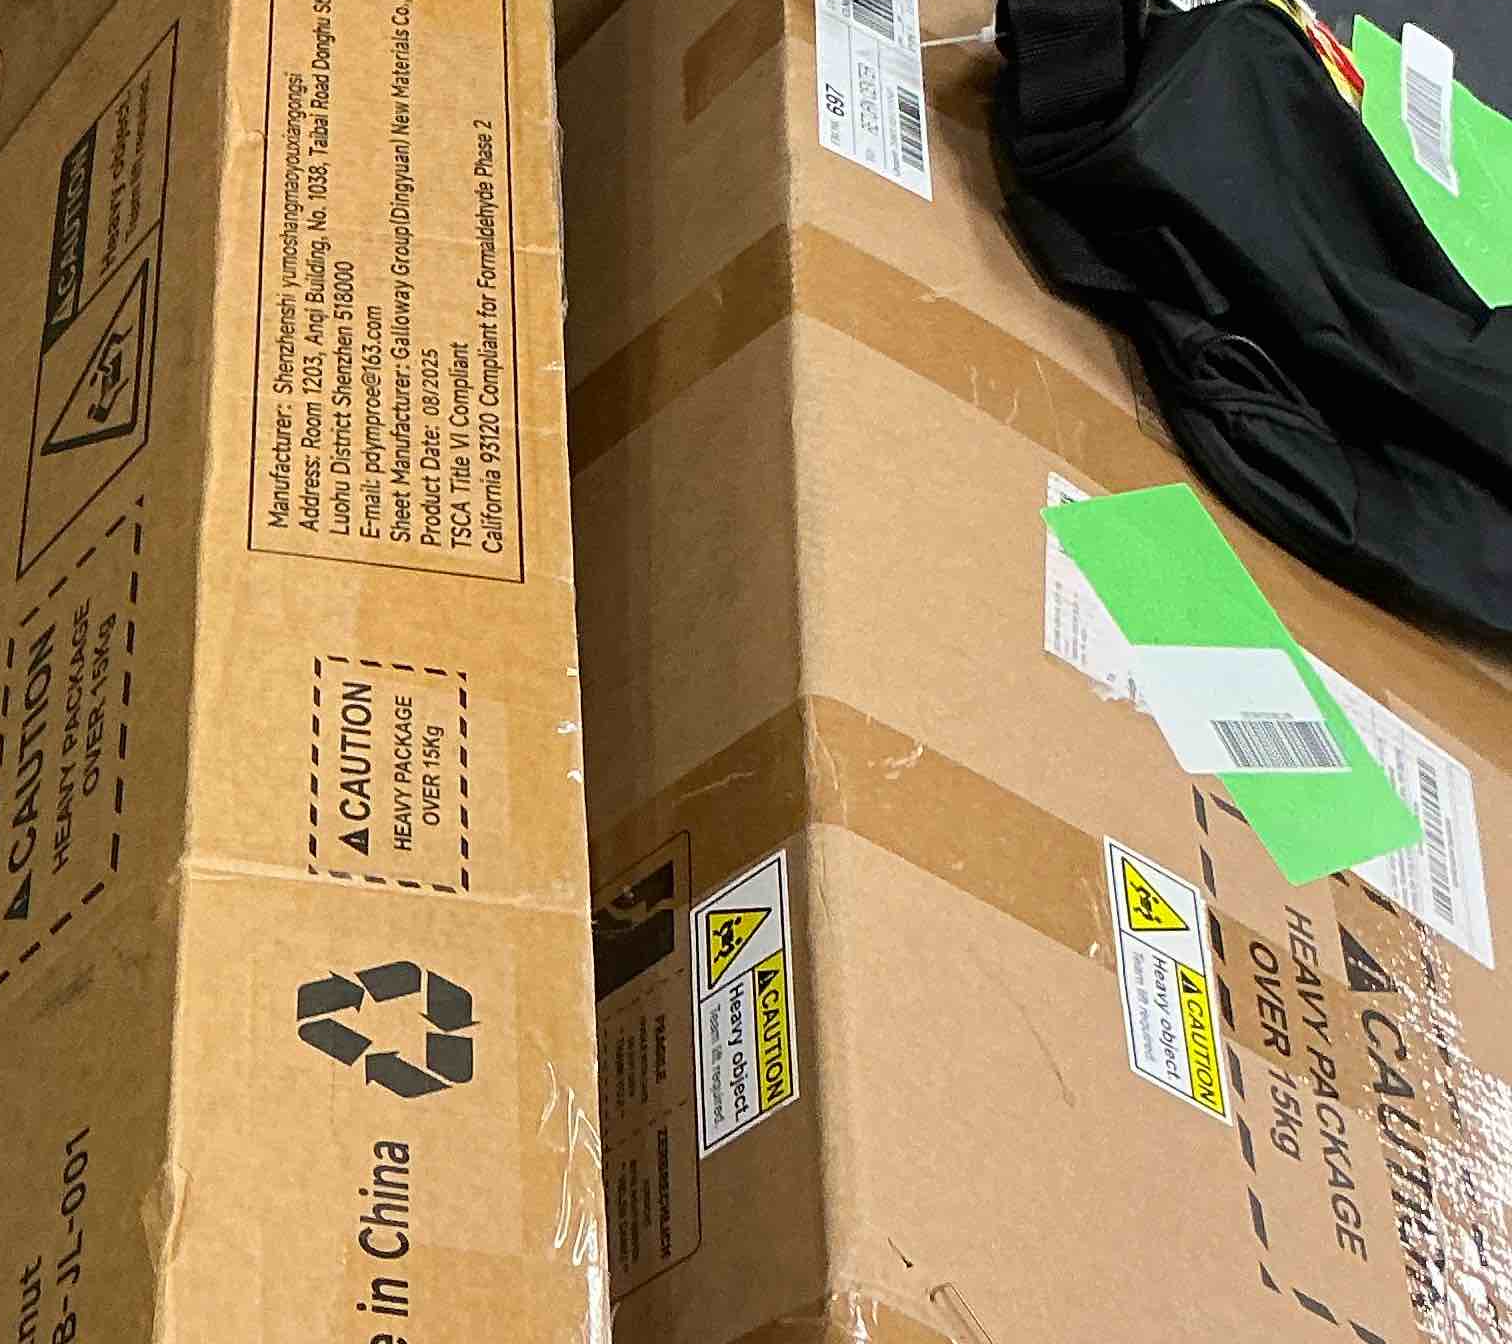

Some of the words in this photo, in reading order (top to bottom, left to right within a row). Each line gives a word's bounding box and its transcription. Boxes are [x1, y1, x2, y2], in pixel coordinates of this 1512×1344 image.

[312, 17, 335, 71] Donghu
[391, 29, 410, 99] Materials
[311, 72, 329, 111] Road
[391, 109, 410, 138] New
[473, 118, 492, 129] 2
[825, 82, 845, 119] 697
[309, 114, 329, 157] Taibai
[473, 131, 494, 178] Phase
[308, 162, 331, 201] 1038,
[307, 210, 329, 231] No.
[474, 180, 499, 290] Formaldehyde
[333, 260, 355, 320] 518000
[391, 279, 415, 360] Galloway
[476, 293, 498, 322] for
[273, 293, 296, 396] Shenzhenshi
[303, 352, 328, 396] 1203,
[331, 327, 353, 406] Shenzhen
[478, 322, 504, 408] Compliant
[421, 347, 441, 417] 08/2025
[449, 341, 474, 428] Compliant
[301, 400, 322, 450] Room
[331, 419, 351, 475] District
[391, 364, 411, 486] Manufacturer:
[420, 423, 441, 471] Date:
[450, 432, 470, 452] VI
[478, 412, 501, 463] 93120
[268, 404, 293, 529] Manufacturer:
[299, 453, 322, 533] Address:
[450, 455, 471, 493] Title
[330, 482, 351, 536] Luohu
[359, 479, 381, 539] E-mail:
[390, 490, 411, 544] Sheet
[420, 476, 442, 547] Product
[450, 503, 472, 549] TSCA
[479, 468, 504, 555] California
[61, 600, 90, 756] PACKAGE
[7, 622, 56, 873] CAUTION
[82, 701, 106, 798] OVER
[339, 680, 373, 822] CAUTION
[393, 695, 413, 784] PACKAGE
[423, 724, 445, 768] 15Kg
[51, 759, 73, 875] HEAVY
[393, 787, 413, 853] HEAVY
[423, 770, 441, 826] OVER
[1150, 954, 1169, 1016] Heavy
[1249, 940, 1292, 1057] OVER
[1284, 904, 1331, 1046] HEAVY
[728, 981, 745, 1054] Heavy
[760, 987, 785, 1108] CAUTION
[1184, 1001, 1218, 1105] CAUTION
[1267, 1068, 1304, 1163] 15kg
[1307, 1047, 1369, 1262] PACKAGE
[358, 1140, 410, 1260] China
[356, 1276, 410, 1317] in
